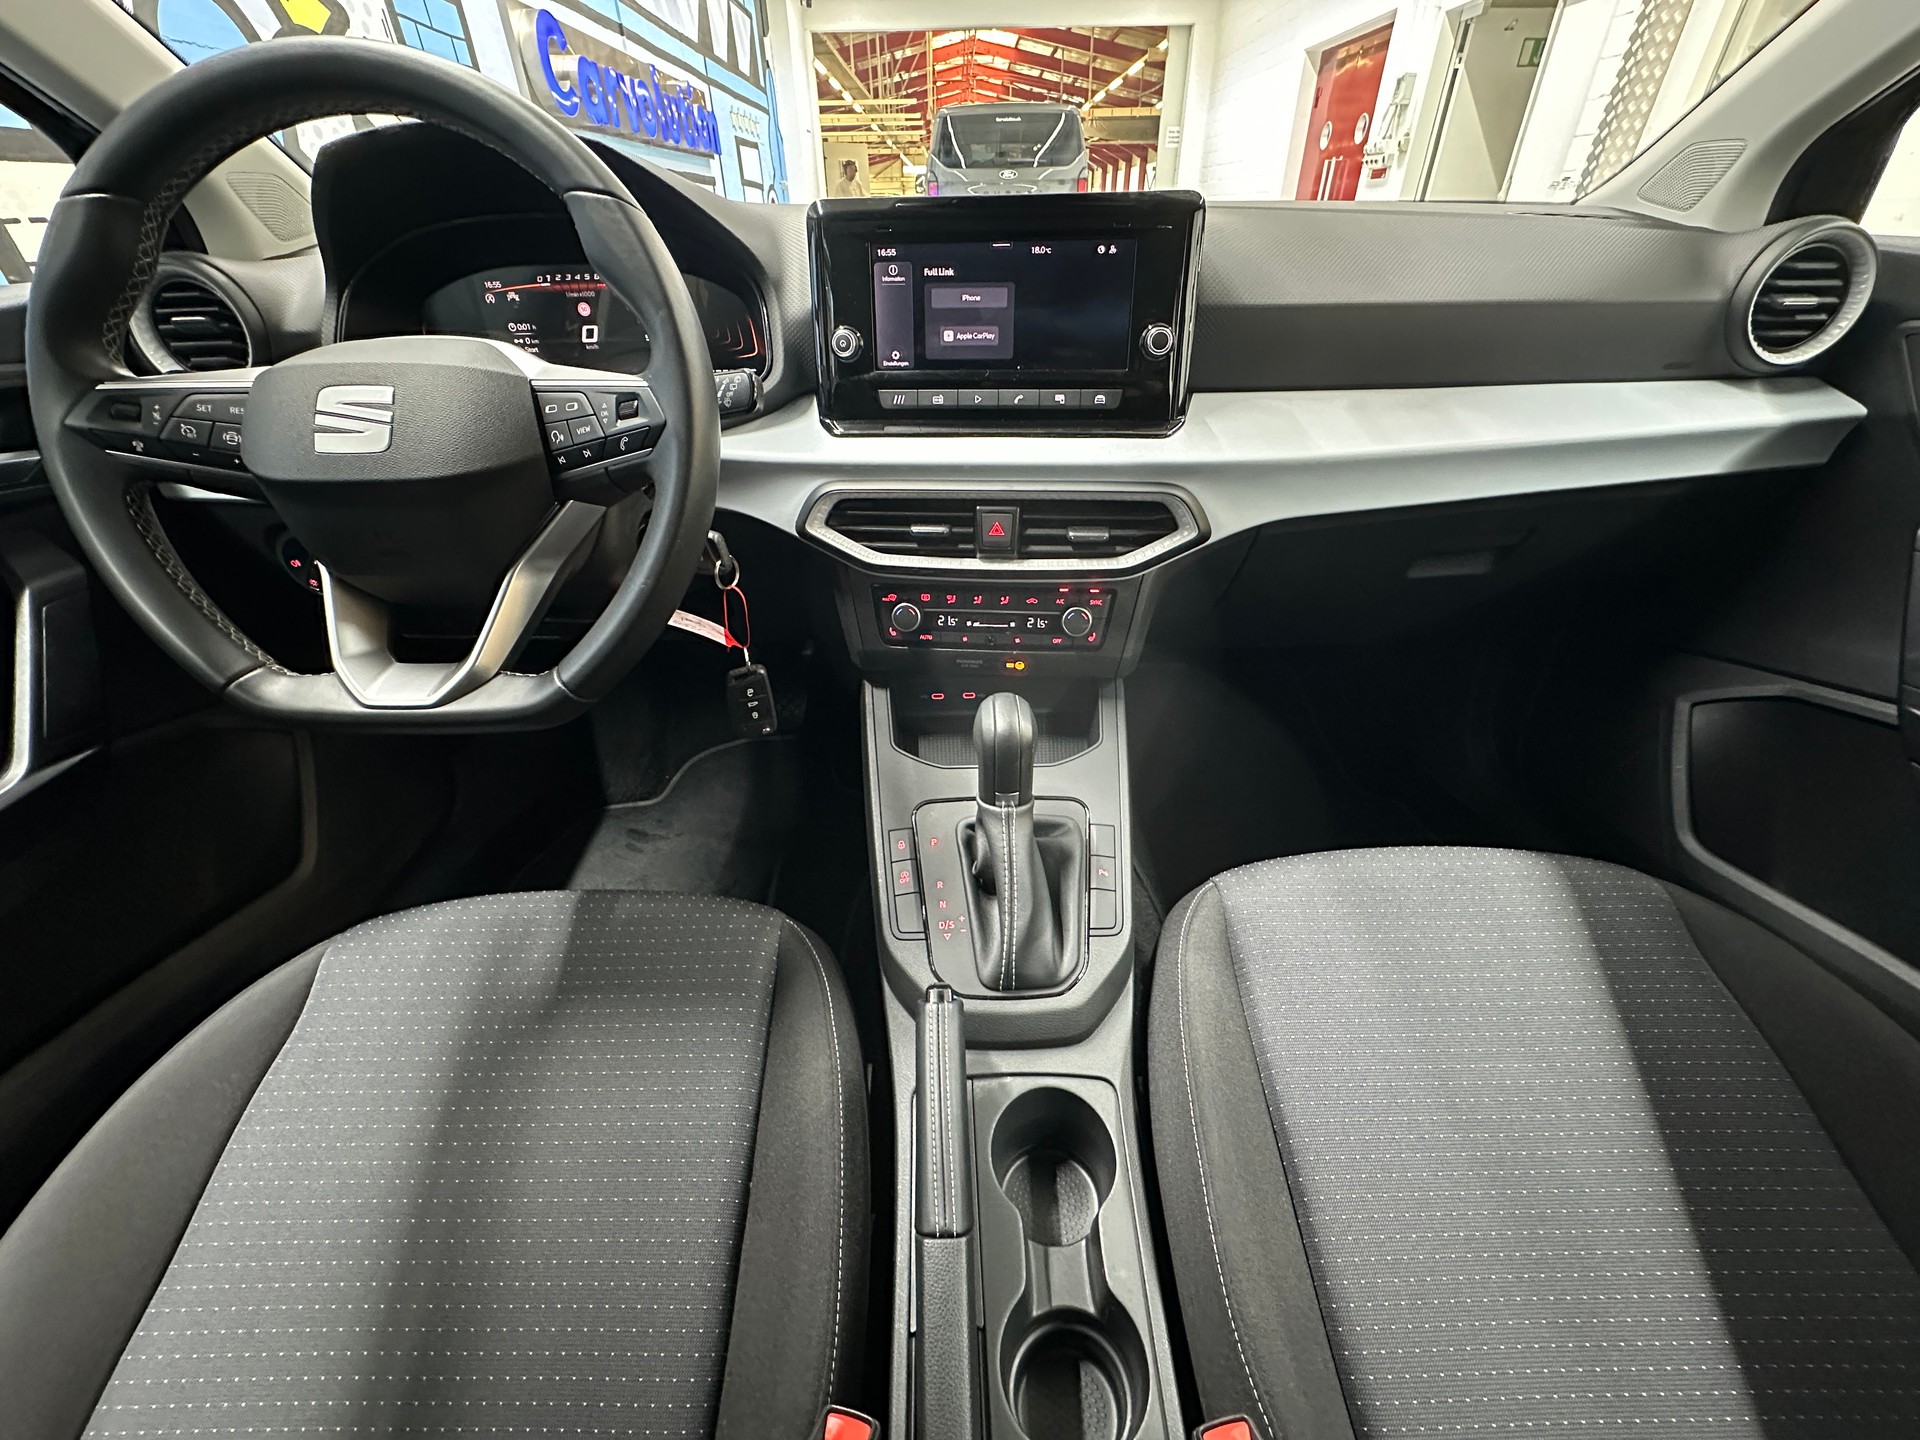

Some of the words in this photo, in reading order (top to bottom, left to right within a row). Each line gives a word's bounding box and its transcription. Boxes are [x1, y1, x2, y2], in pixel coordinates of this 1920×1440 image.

[535, 8, 722, 155] Carvolution
[877, 248, 897, 257] 16:55
[924, 268, 938, 276] Full
[939, 267, 954, 276] Link
[545, 274, 551, 282] 1
[484, 281, 502, 289] 16:55
[961, 294, 981, 302] iPhone
[956, 332, 972, 341] Apple
[973, 332, 996, 341] CarPlay
[196, 404, 212, 412] SET
[576, 425, 591, 435] VIEW
[940, 900, 947, 908] N
[938, 921, 955, 929] D/S
